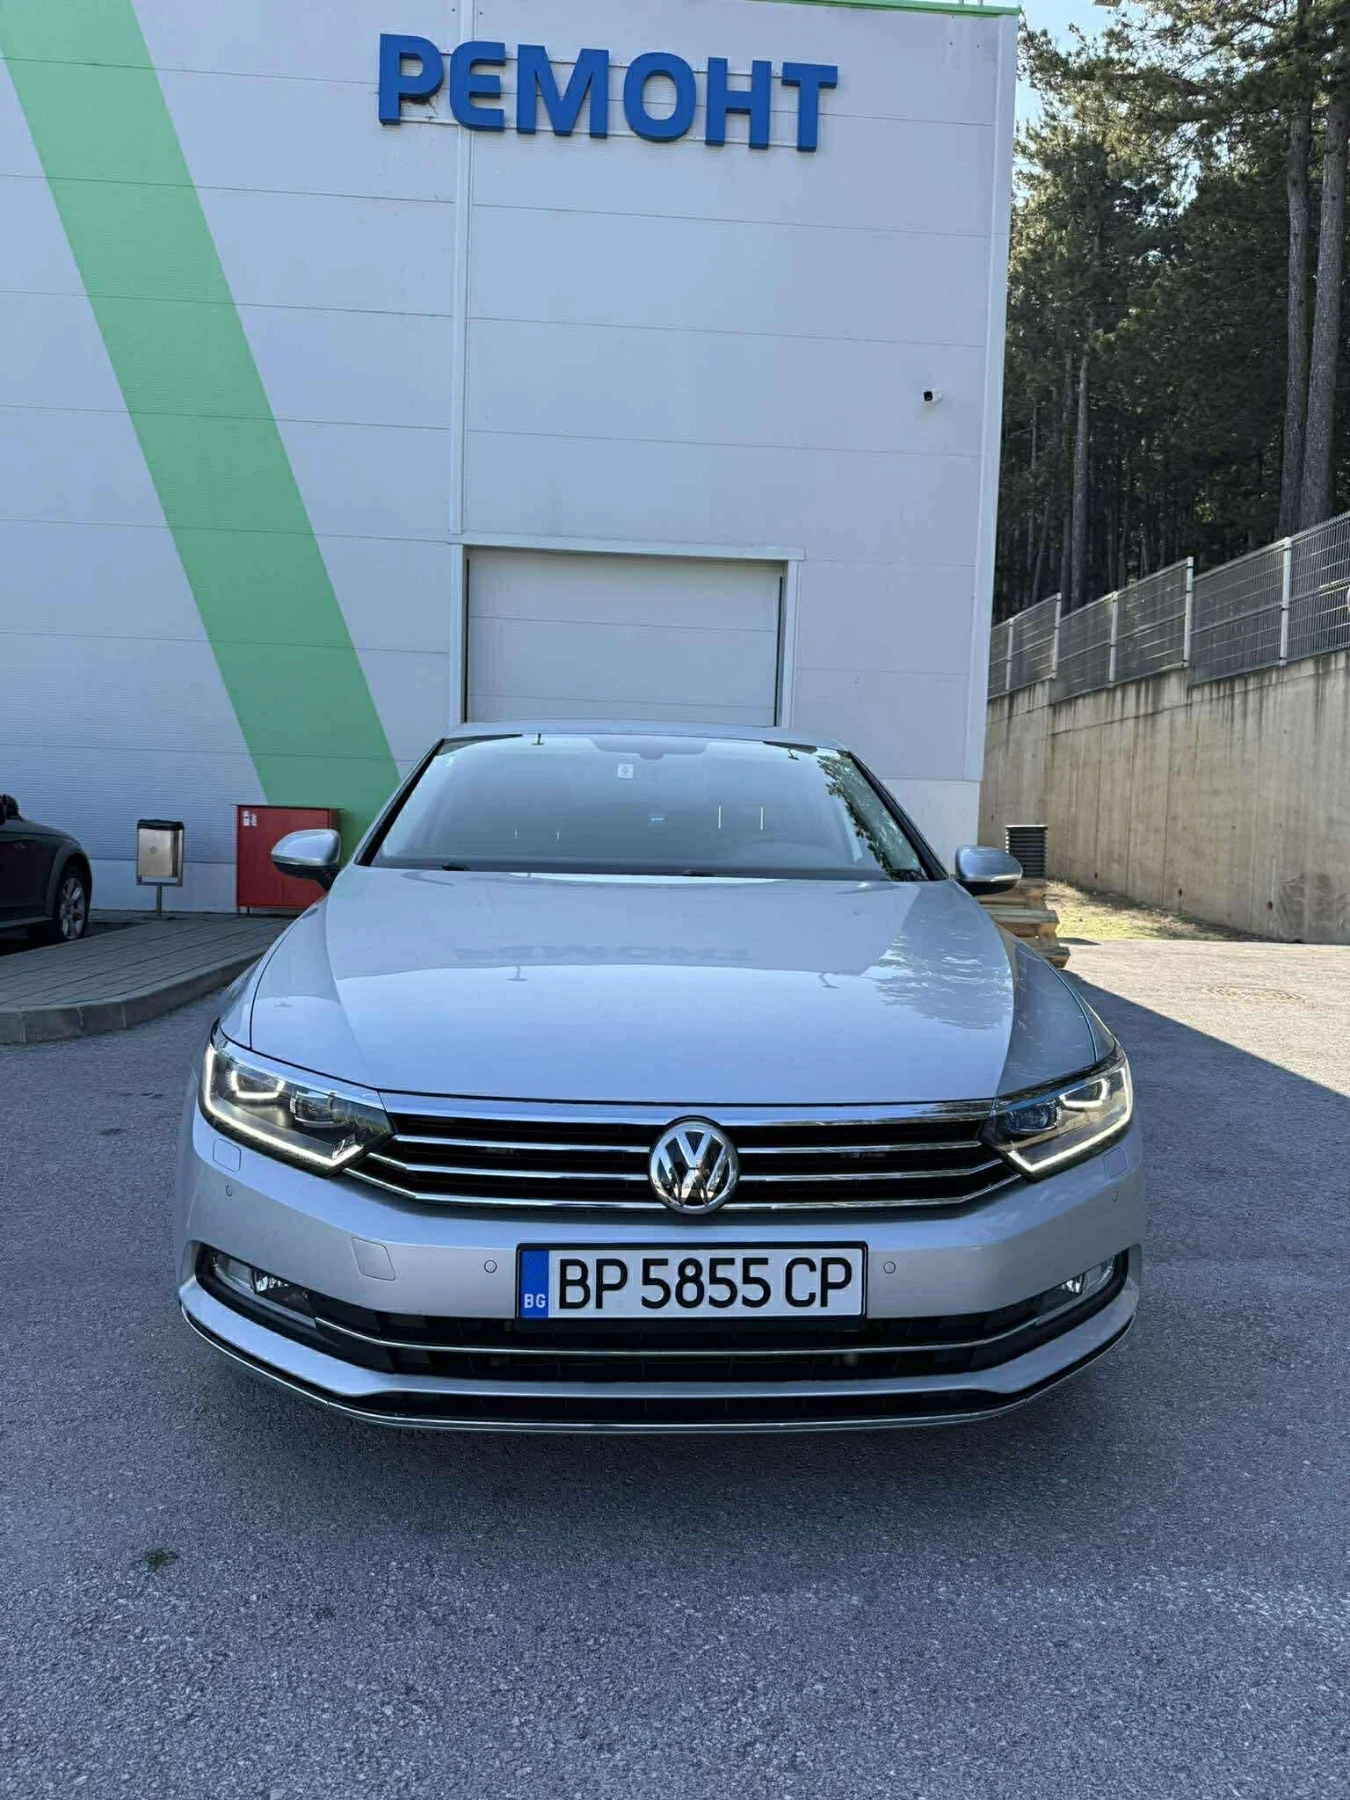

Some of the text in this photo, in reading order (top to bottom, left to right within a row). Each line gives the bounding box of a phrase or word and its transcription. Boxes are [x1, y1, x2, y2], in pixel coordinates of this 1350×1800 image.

[379, 33, 838, 153] РЕМОНТ
[524, 1293, 546, 1309] BG
[558, 1256, 853, 1309] BP 5855 CP
